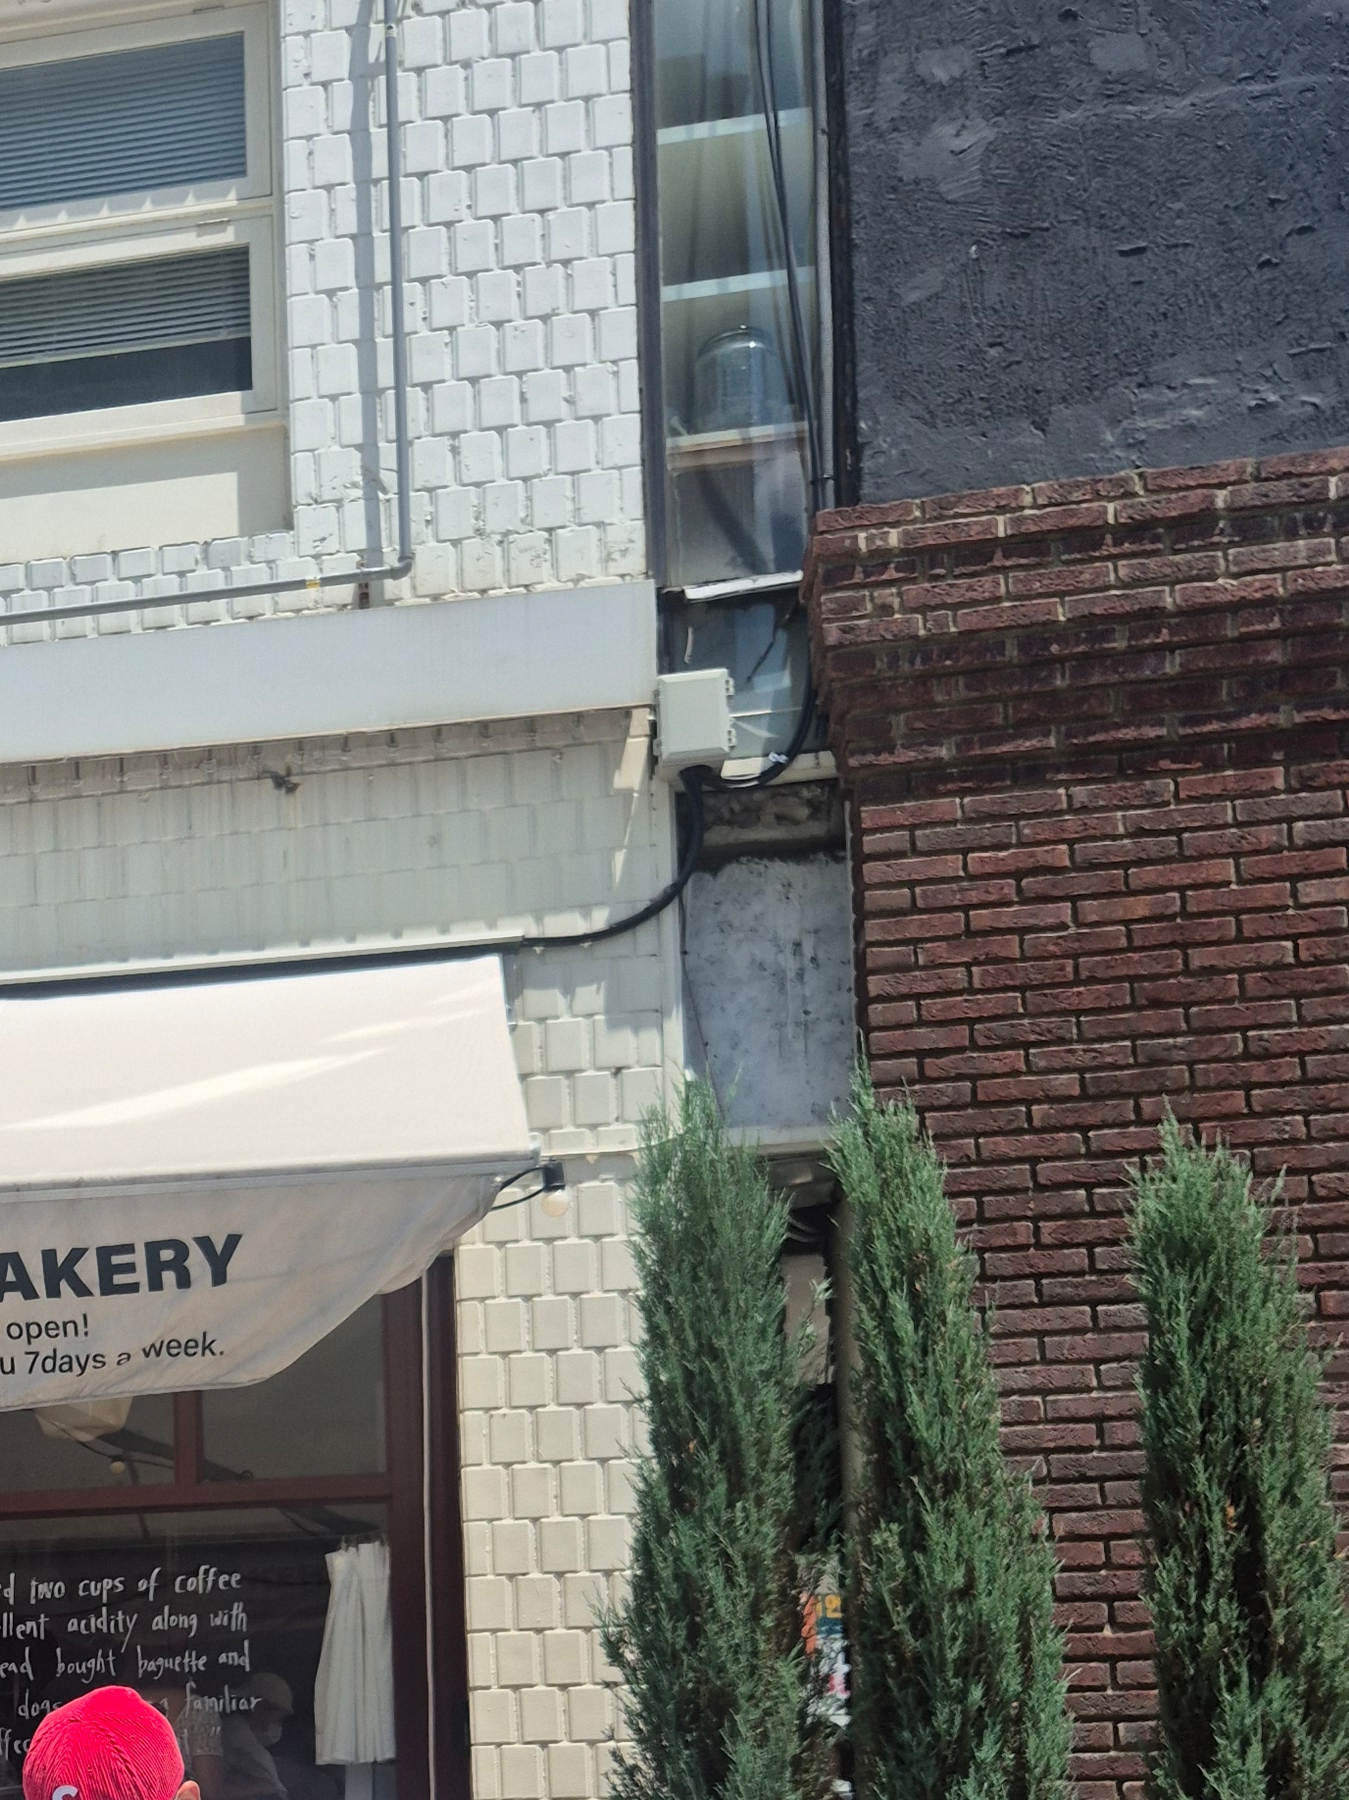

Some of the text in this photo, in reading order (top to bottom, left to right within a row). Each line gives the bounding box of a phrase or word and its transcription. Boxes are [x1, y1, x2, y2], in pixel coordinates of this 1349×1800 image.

[6, 1313, 89, 1345] open!
[24, 1348, 106, 1377] 7days
[116, 1352, 131, 1366] a
[140, 1331, 224, 1359] week.
[30, 1577, 66, 1605] two
[78, 1577, 125, 1604] cups
[137, 1566, 162, 1601] of
[174, 1564, 242, 1594] coffee
[67, 1606, 138, 1653] acidity
[151, 1604, 198, 1638] along
[210, 1602, 248, 1632] with
[56, 1647, 116, 1684] bought
[137, 1645, 208, 1680] baguette
[218, 1639, 250, 1672] and
[185, 1681, 263, 1718] familiar
